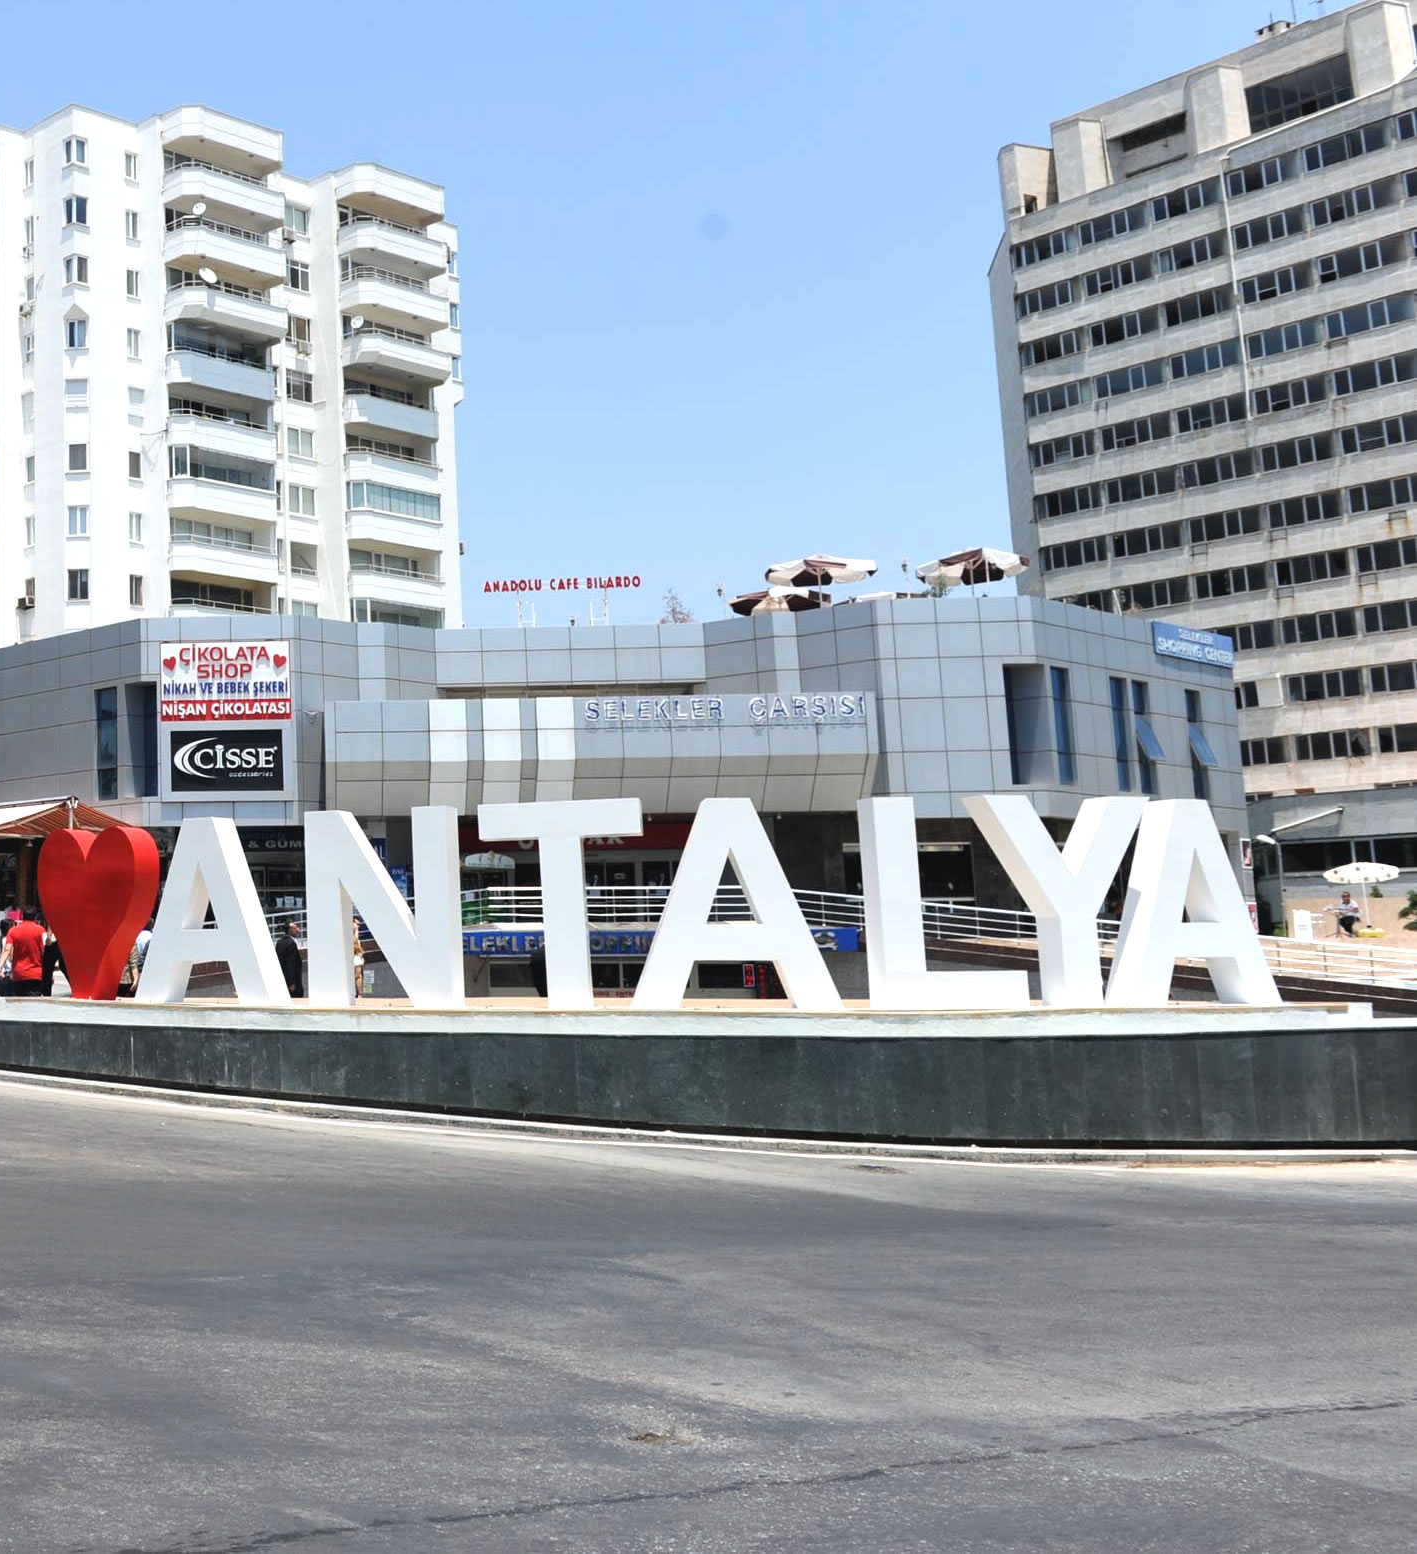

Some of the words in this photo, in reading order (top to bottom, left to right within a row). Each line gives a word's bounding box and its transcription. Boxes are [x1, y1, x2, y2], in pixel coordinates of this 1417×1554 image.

[483, 579, 542, 593] ANADOLU
[550, 578, 579, 590] CAFE
[586, 576, 641, 589] BILARDO
[179, 644, 270, 666] ÇİKOLATA
[197, 663, 252, 680] SHOP
[163, 680, 197, 696] NİKAH
[200, 682, 214, 695] VE
[217, 681, 250, 695] BEBEK
[253, 677, 288, 697] ŞEKERİ
[162, 701, 207, 719] NİŞAN
[211, 700, 290, 719] ÇİKOLATASI
[585, 699, 724, 721] SELEKLER
[750, 695, 866, 725] ÇARŞISI
[265, 837, 306, 849] GÜM
[135, 793, 1283, 1011] ANTALYA
